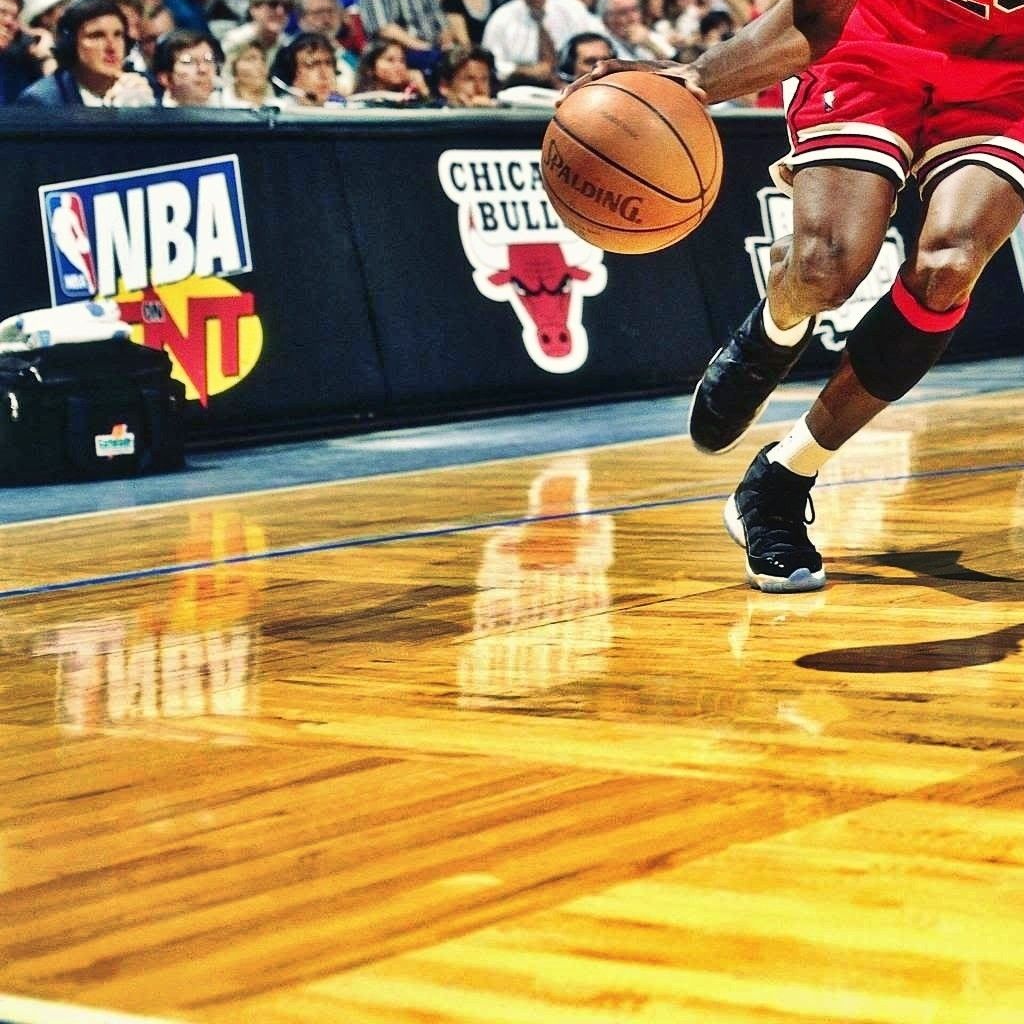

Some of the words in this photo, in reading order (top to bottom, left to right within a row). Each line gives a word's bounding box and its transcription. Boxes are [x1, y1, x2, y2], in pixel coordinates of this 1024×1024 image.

[450, 161, 542, 191] CHICA
[478, 200, 559, 231] BULL
[543, 139, 643, 223] SPALDING
[93, 173, 242, 298] NBA
[117, 287, 254, 408] NT
